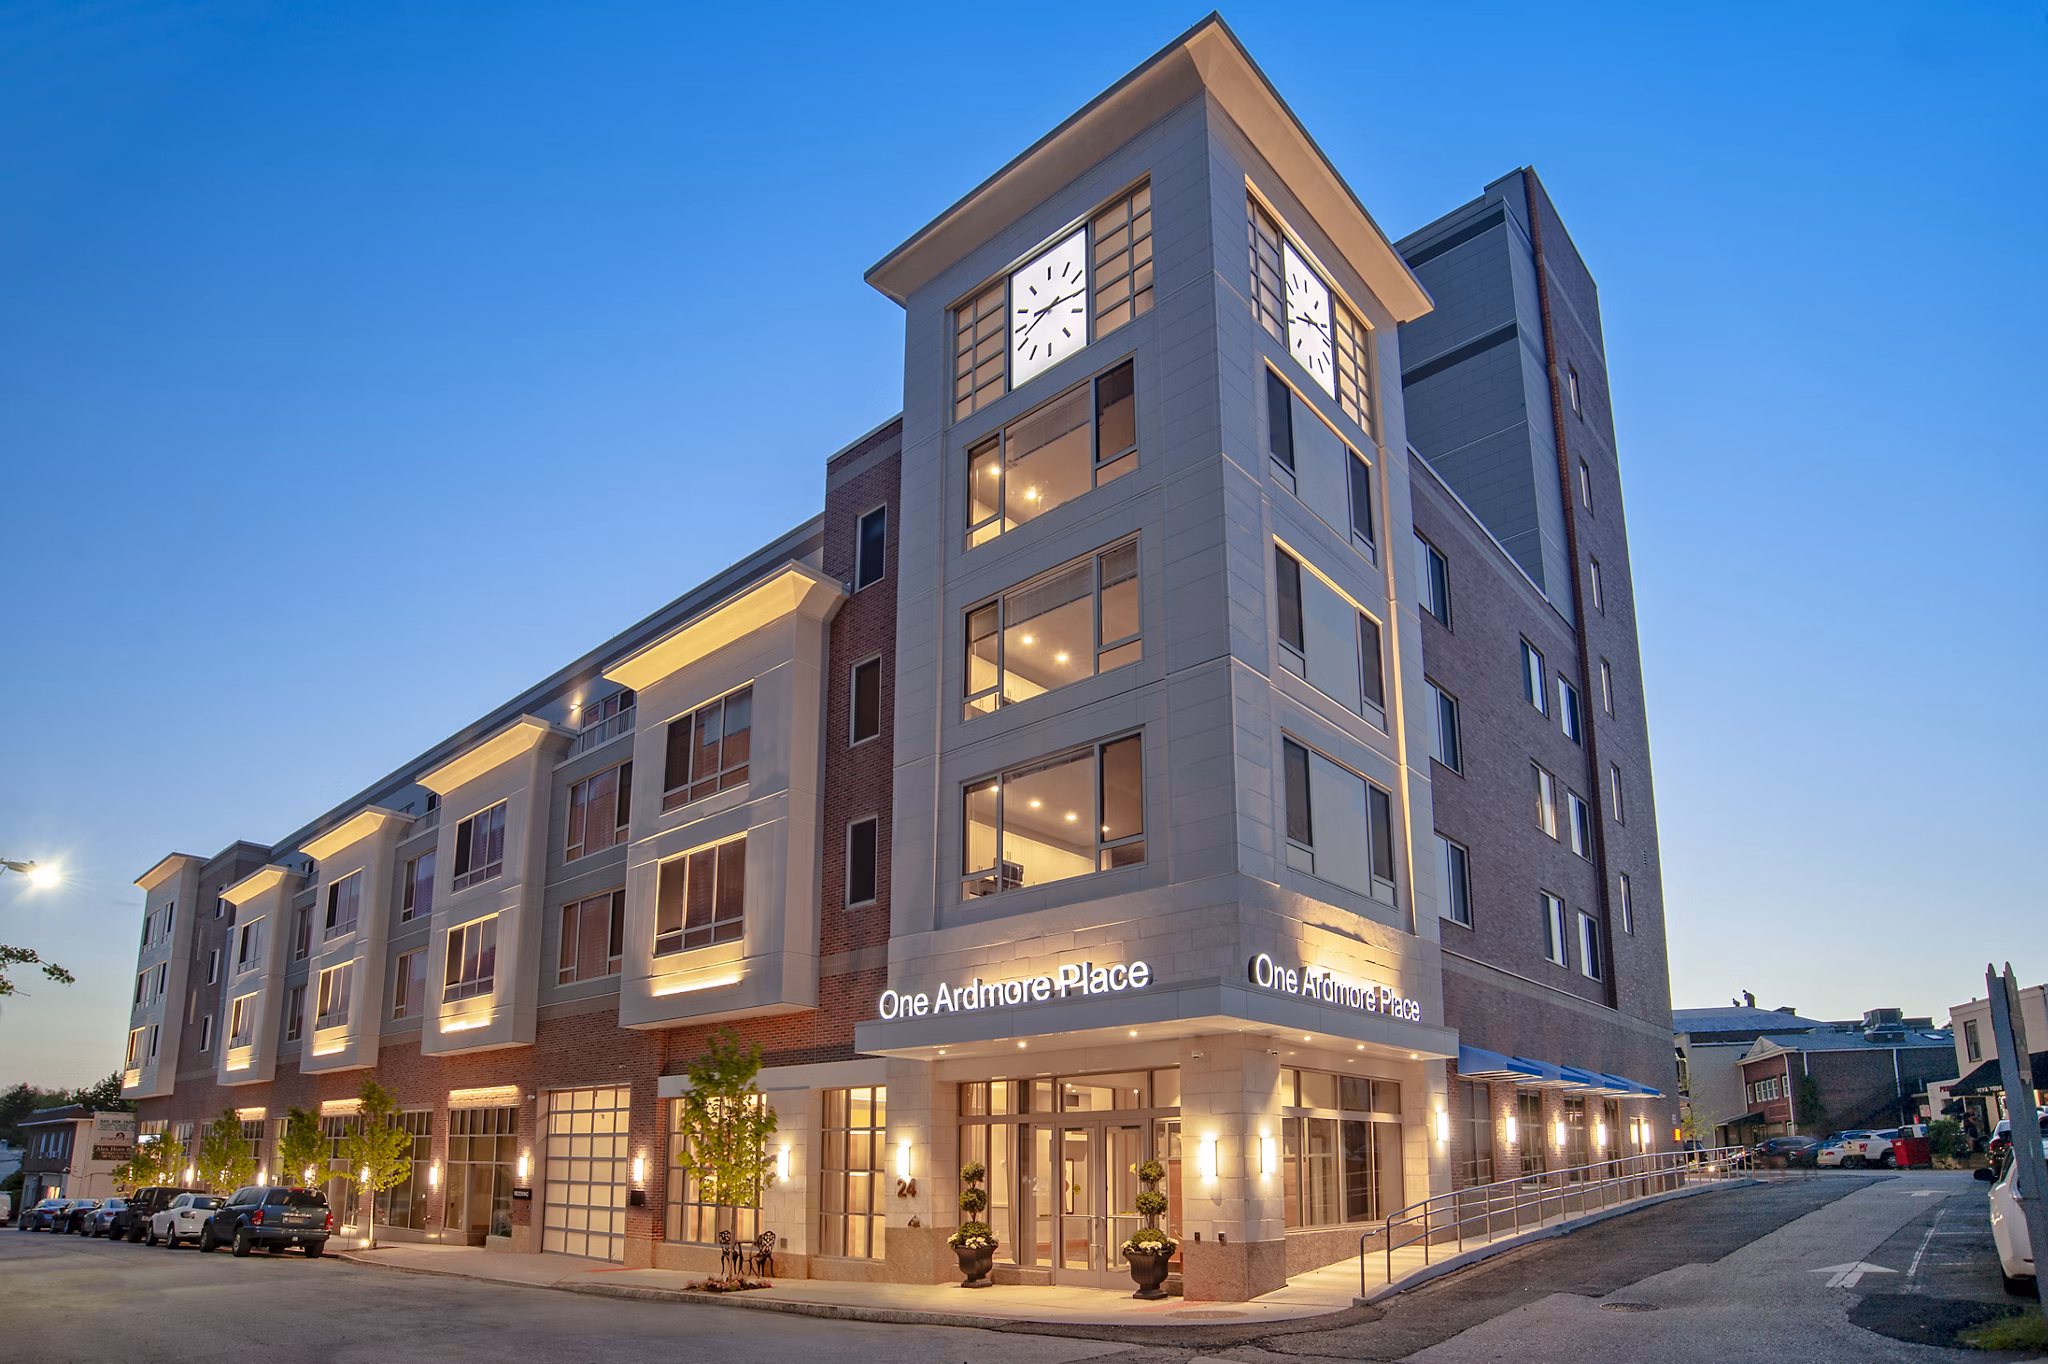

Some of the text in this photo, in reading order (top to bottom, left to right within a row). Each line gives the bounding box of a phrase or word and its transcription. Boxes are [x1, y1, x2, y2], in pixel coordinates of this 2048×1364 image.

[879, 960, 1149, 1020] One Ardmore Place
[1256, 953, 1421, 1022] One Ardmore Place
[897, 1178, 917, 1198] 24
